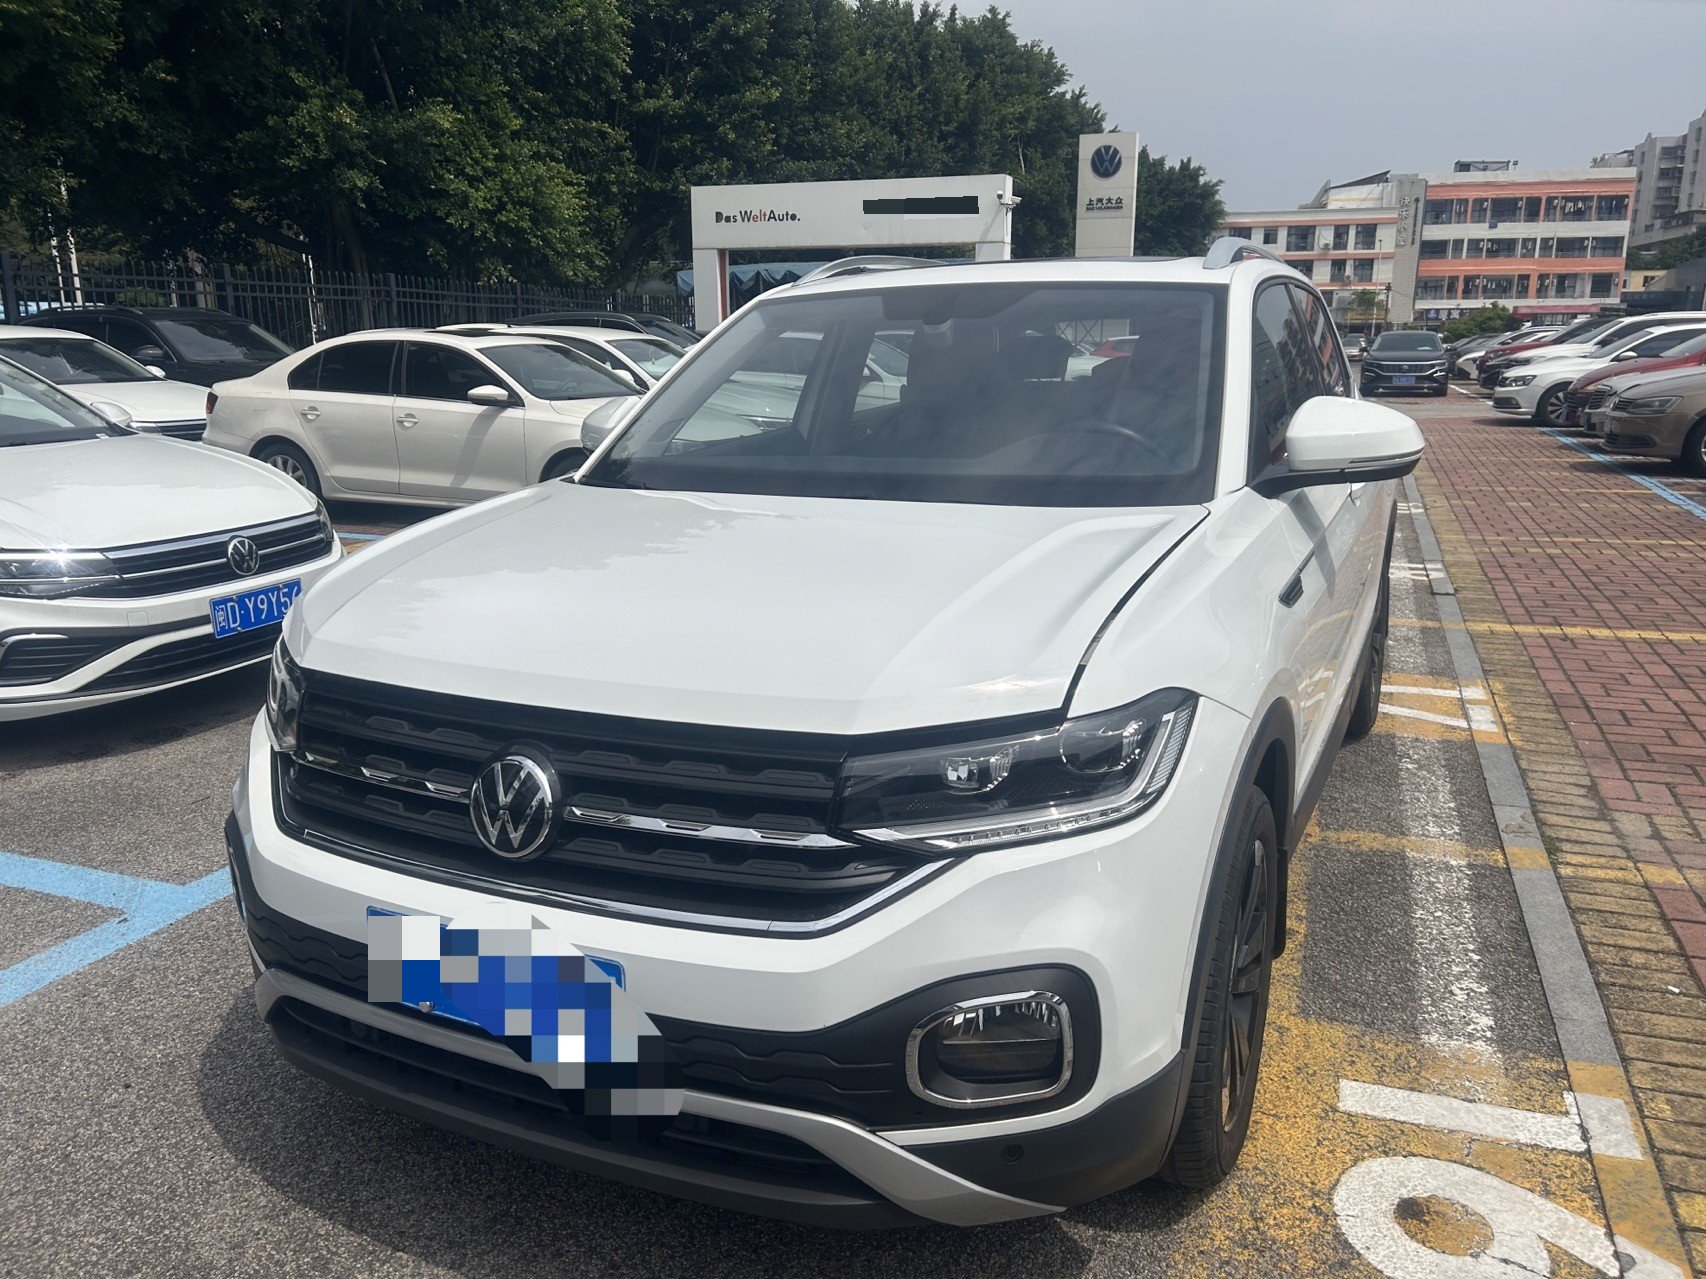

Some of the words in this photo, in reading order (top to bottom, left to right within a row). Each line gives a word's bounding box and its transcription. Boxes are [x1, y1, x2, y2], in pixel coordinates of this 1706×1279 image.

[1086, 196, 1123, 206] 上汽大众
[715, 211, 738, 223] Das
[739, 209, 800, 222] WeltAuto.
